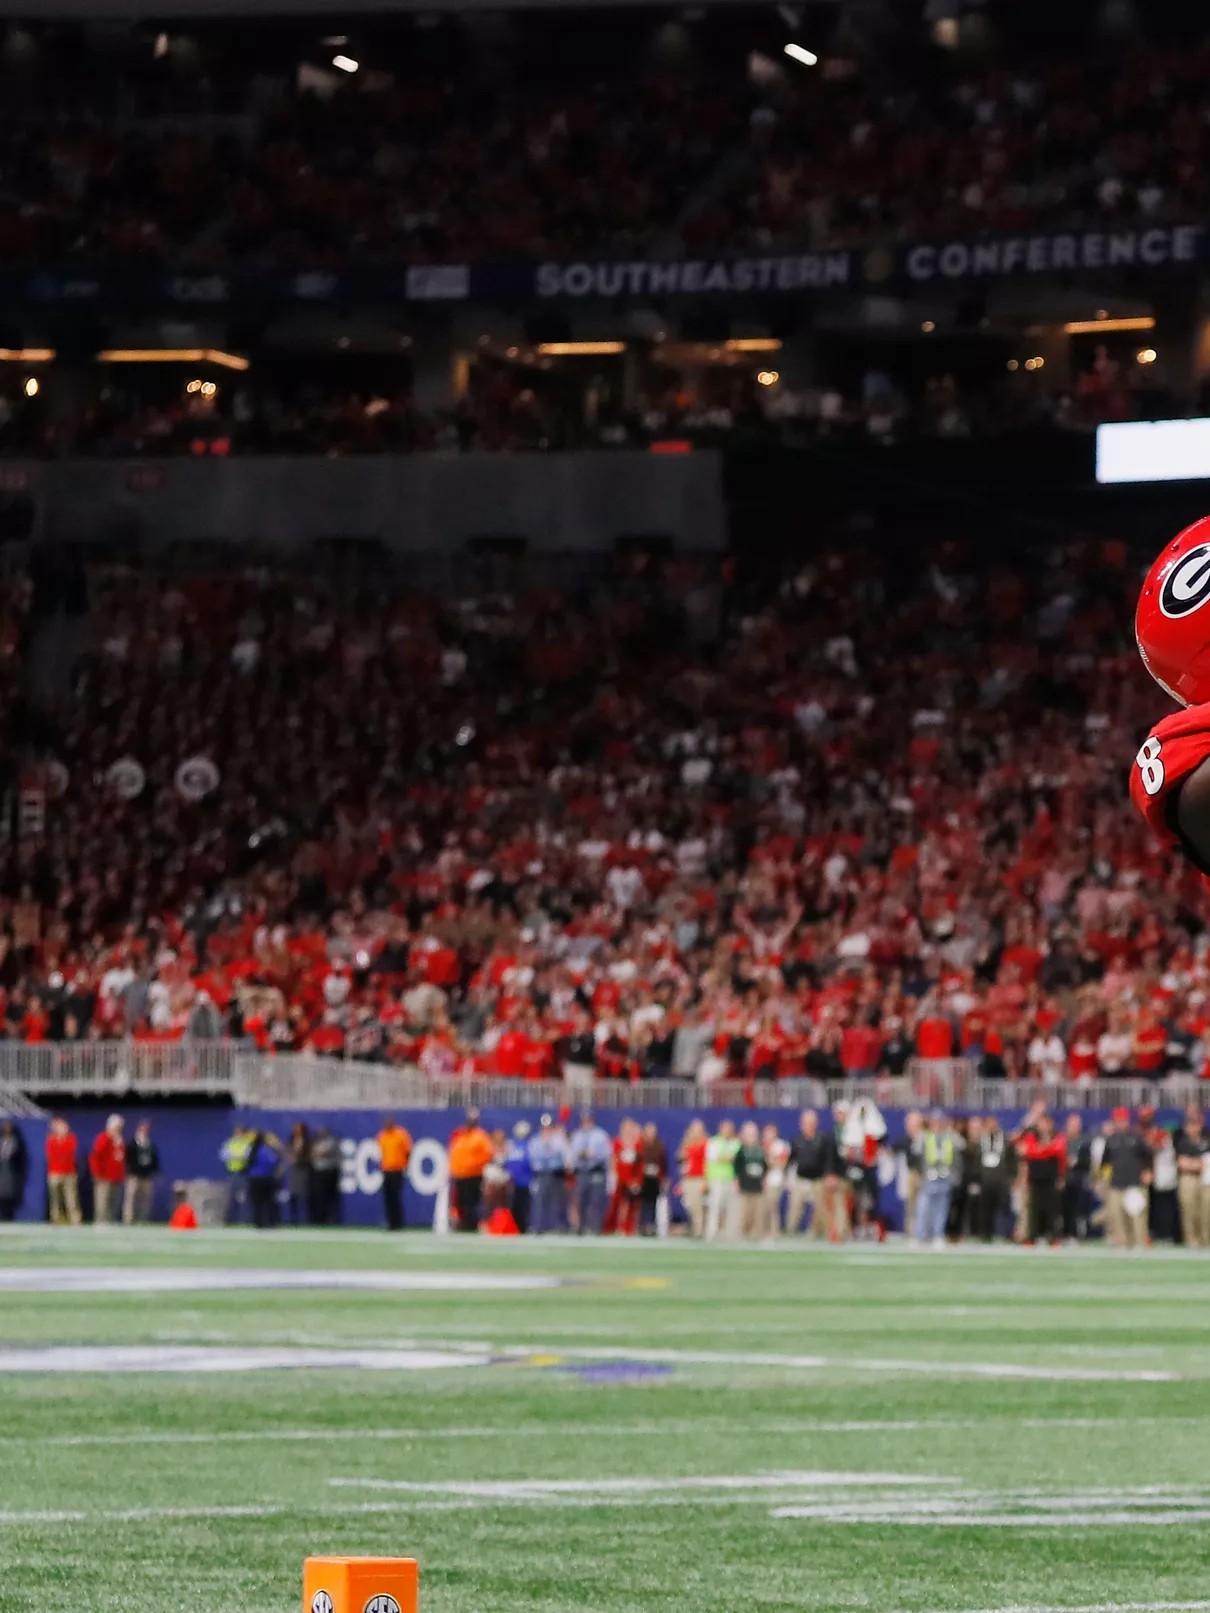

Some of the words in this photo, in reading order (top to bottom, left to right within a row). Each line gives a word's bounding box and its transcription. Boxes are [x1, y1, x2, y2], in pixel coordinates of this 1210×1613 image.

[535, 254, 849, 296] SOUTHEASTERN
[905, 225, 1198, 279] CONFERENCE
[1136, 736, 1164, 795] 8
